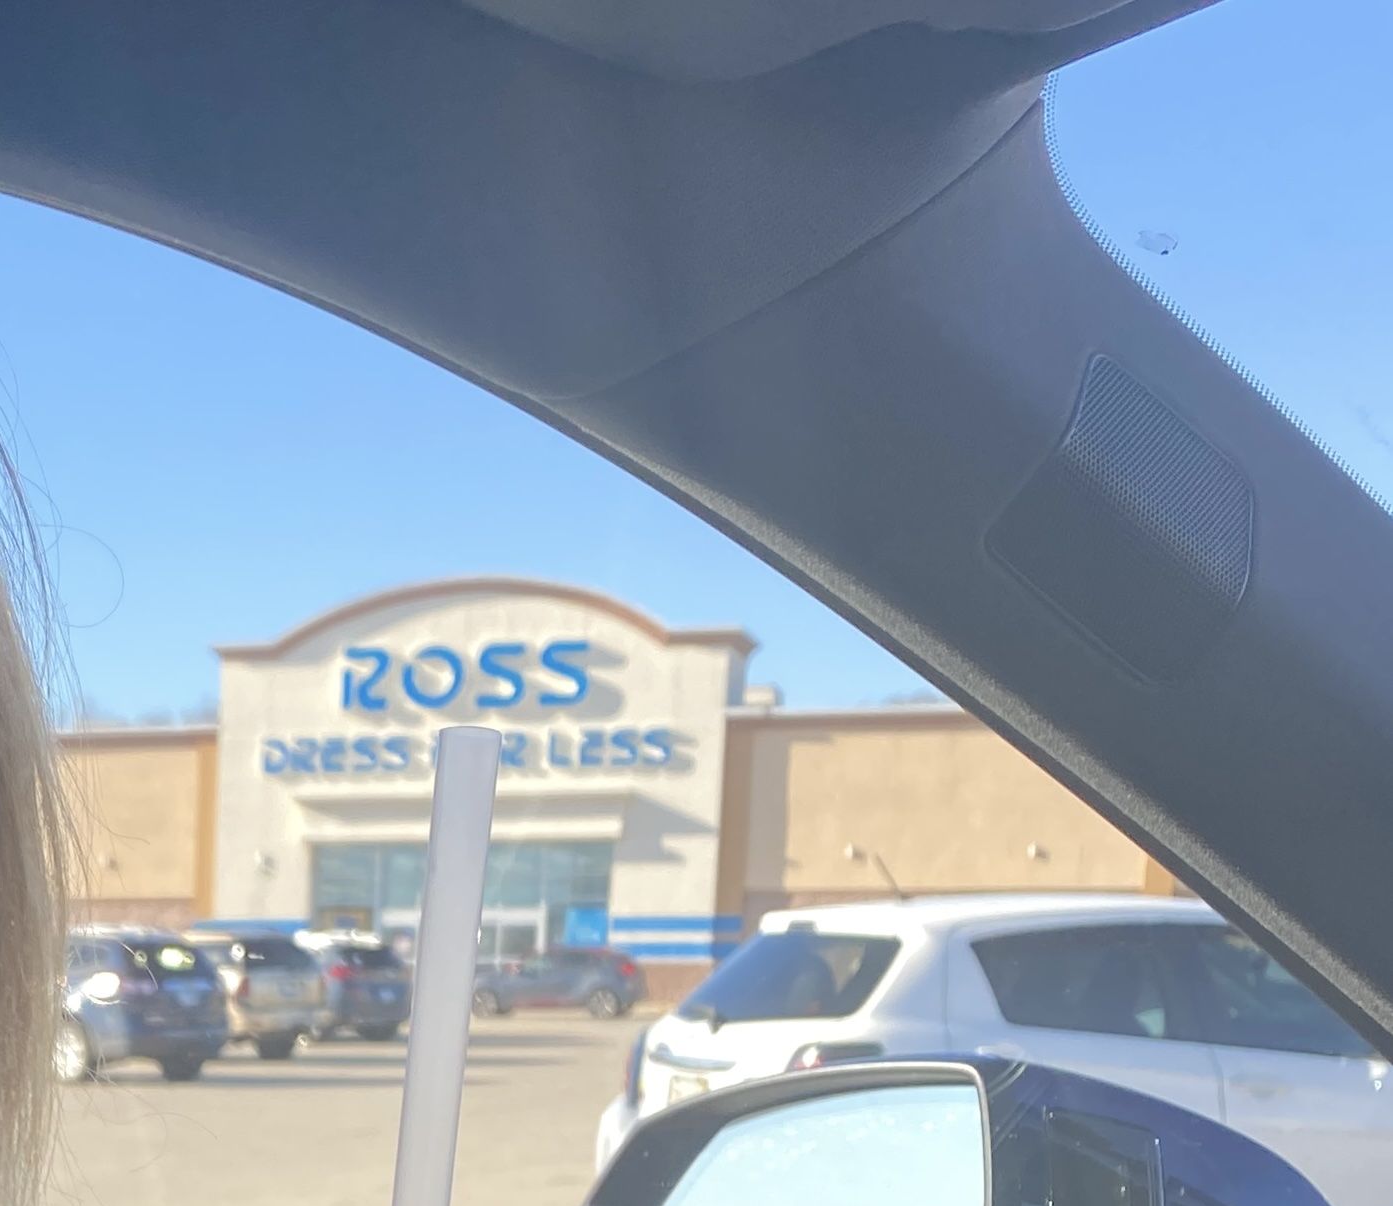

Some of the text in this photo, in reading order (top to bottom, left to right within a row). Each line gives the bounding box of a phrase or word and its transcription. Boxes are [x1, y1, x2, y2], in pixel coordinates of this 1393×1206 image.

[342, 641, 591, 711] ROSS
[262, 738, 412, 774] DRESS
[548, 728, 674, 768] LESS
